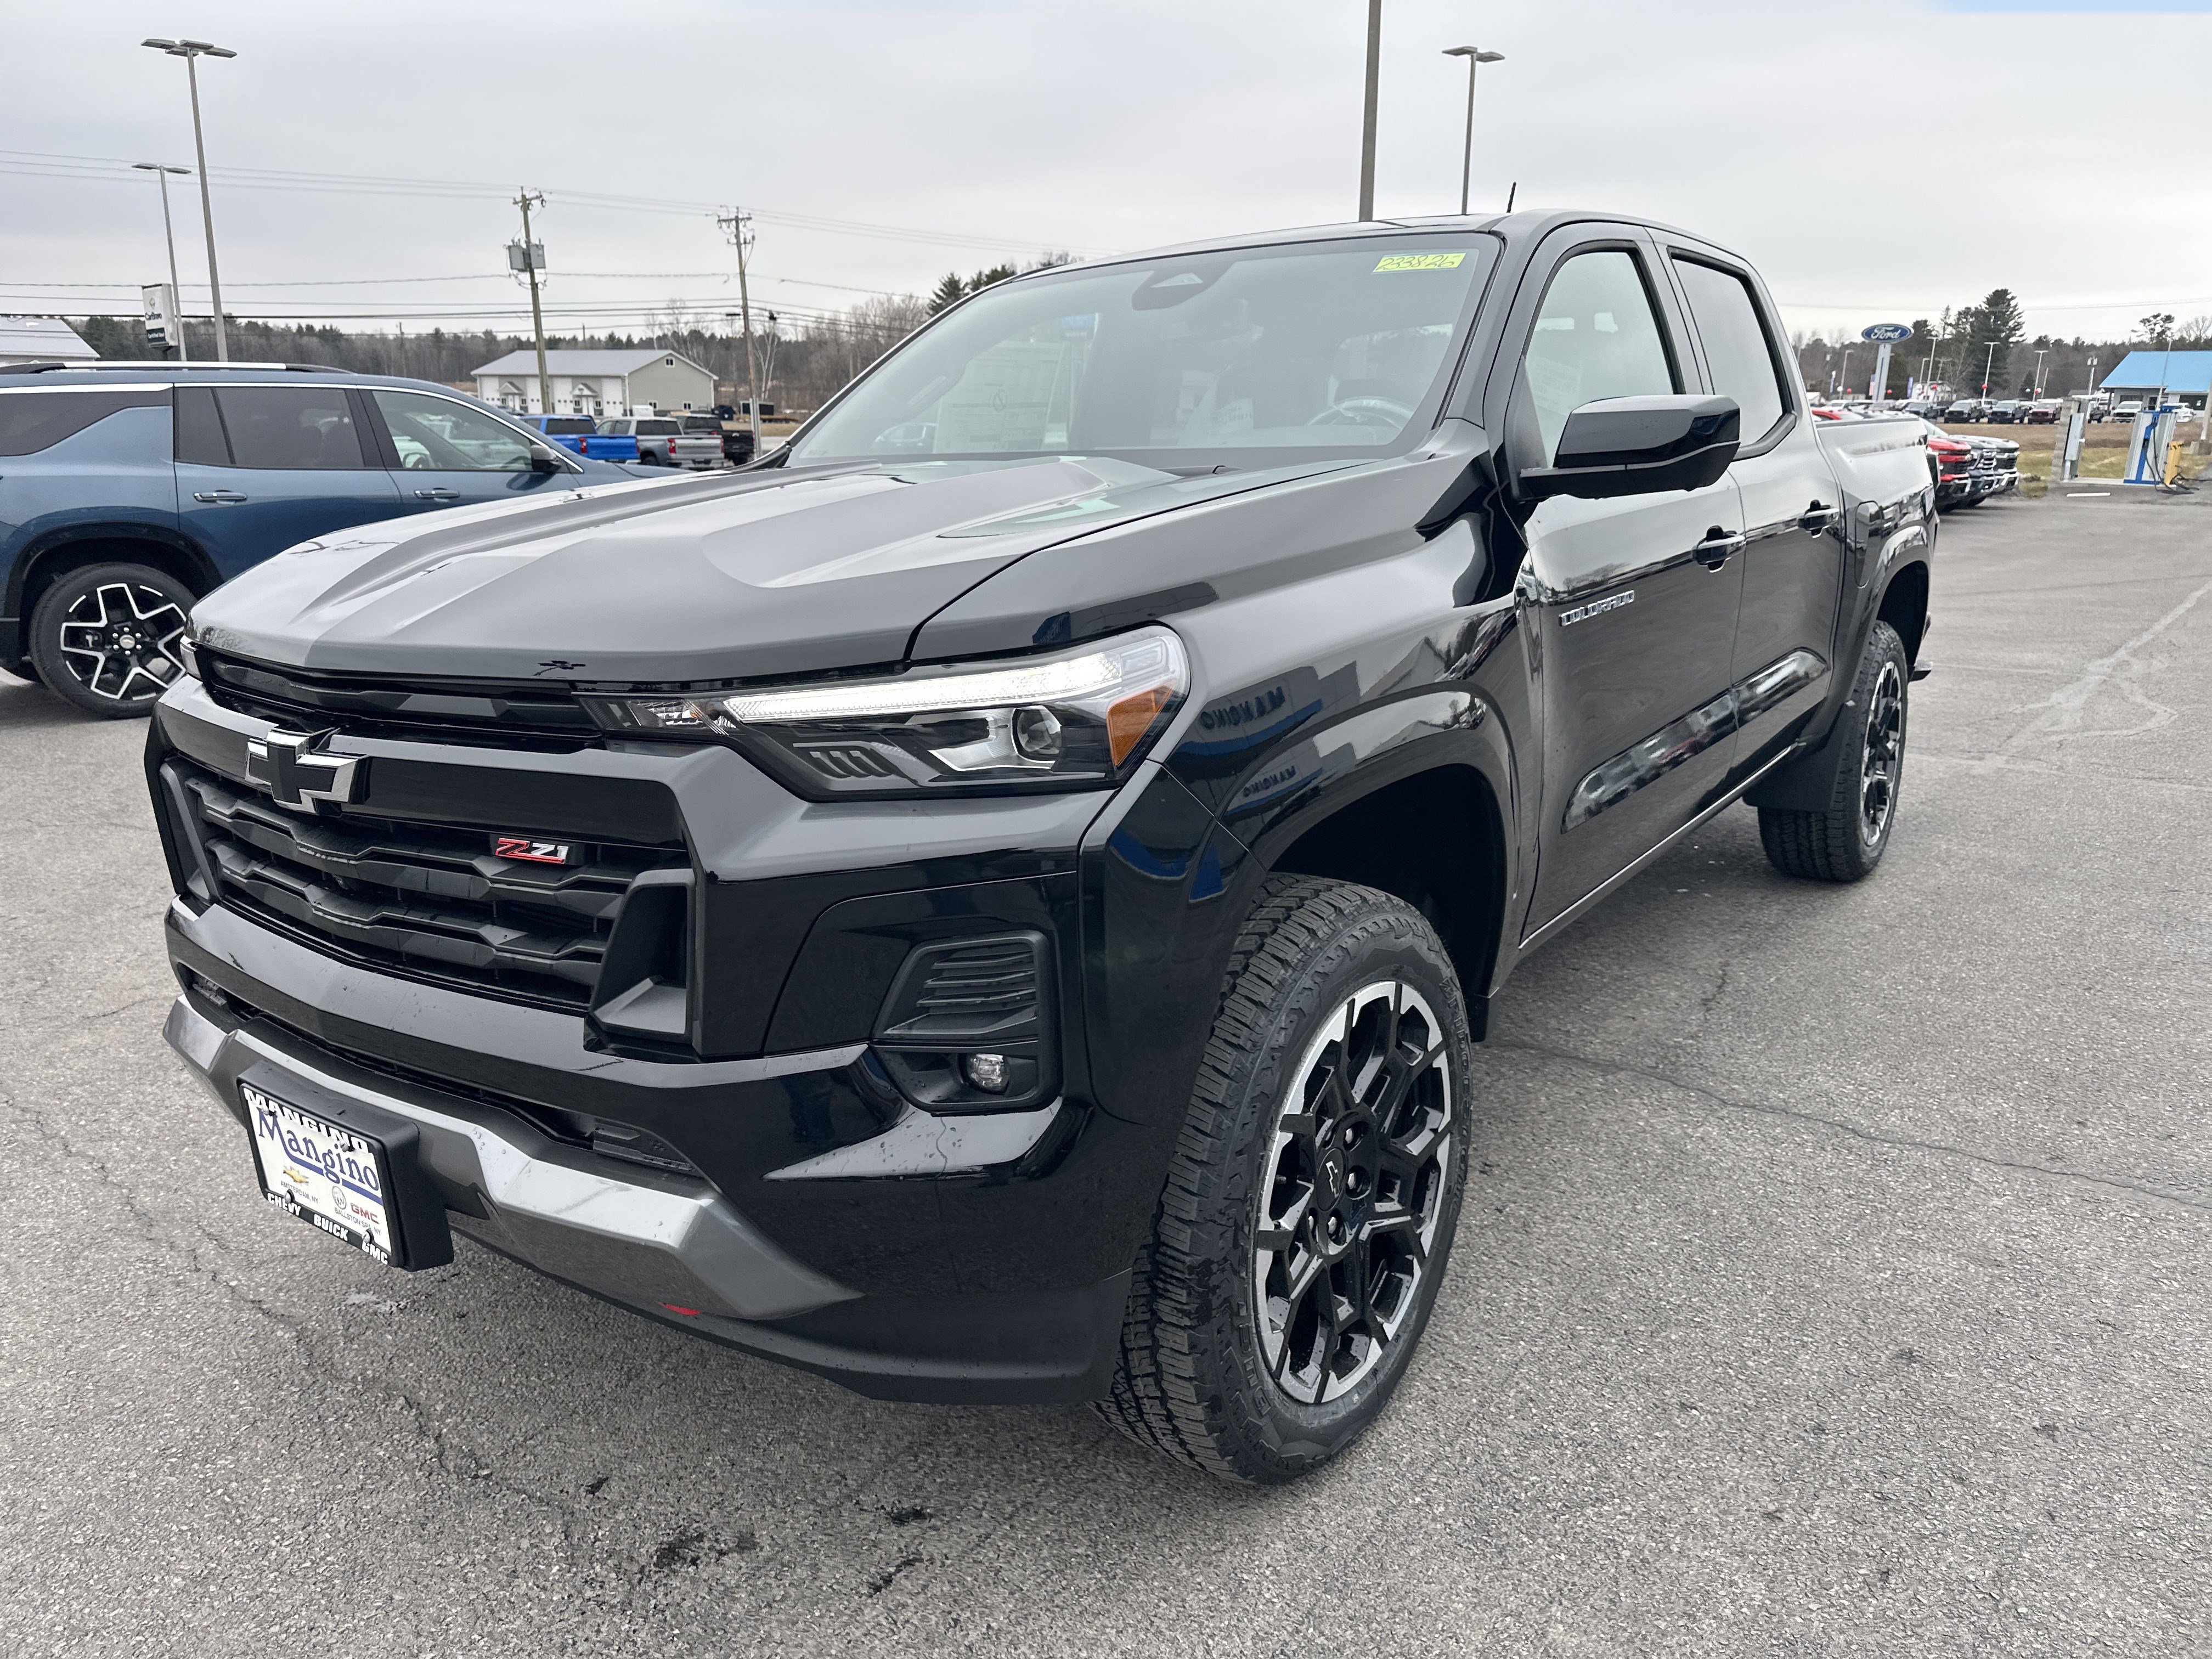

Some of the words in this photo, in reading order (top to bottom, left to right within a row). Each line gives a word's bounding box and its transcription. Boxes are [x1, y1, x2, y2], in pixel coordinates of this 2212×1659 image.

[1871, 326, 1901, 339] Ford
[1558, 590, 1634, 627] COLORADO
[495, 838, 568, 864] Z71
[243, 1088, 369, 1153] MANGINO
[257, 1107, 379, 1190] Mangino
[312, 1195, 318, 1204] NY
[351, 1203, 380, 1224] GMC
[267, 1193, 301, 1217] CHEVY
[314, 1214, 348, 1242] BUICK
[362, 1240, 388, 1265] GMC
[334, 1207, 361, 1225] BALLSTON
[374, 1227, 381, 1236] NY
